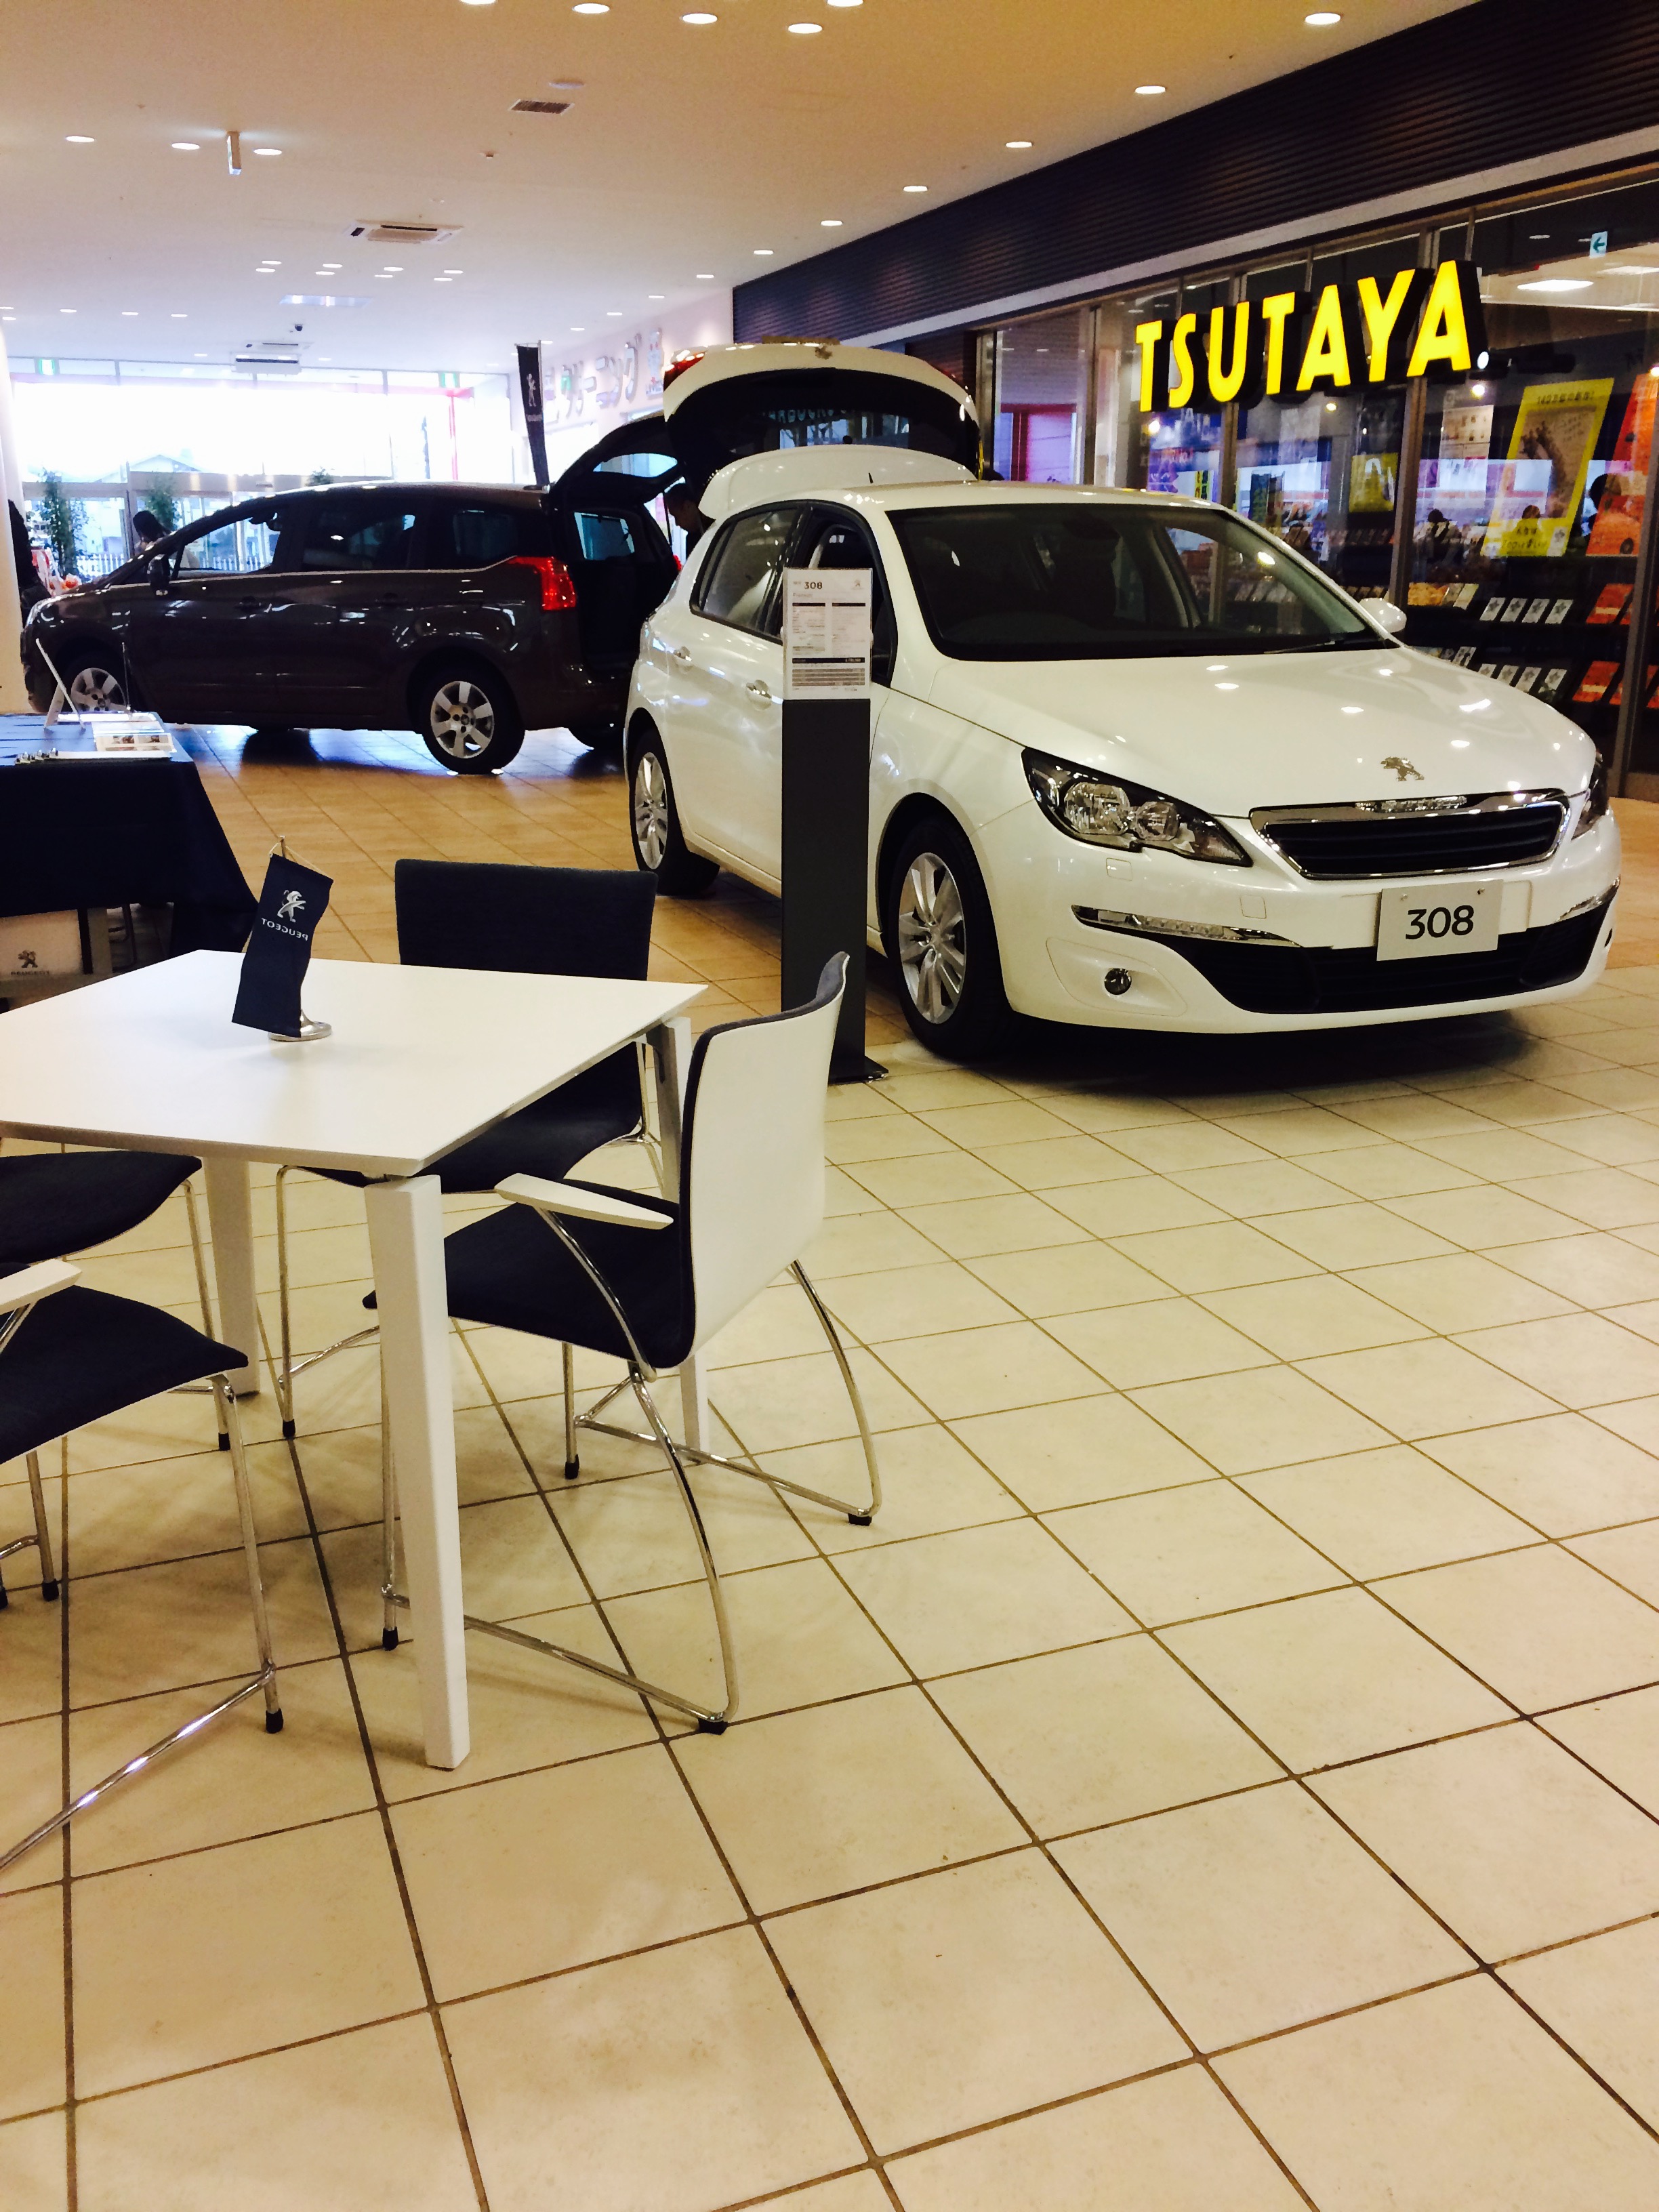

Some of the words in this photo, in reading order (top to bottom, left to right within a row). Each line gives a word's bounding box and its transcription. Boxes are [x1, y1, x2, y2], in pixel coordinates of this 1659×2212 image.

[1135, 260, 1472, 413] TSUTAYA
[804, 581, 823, 590] 308
[1406, 905, 1474, 940] 308
